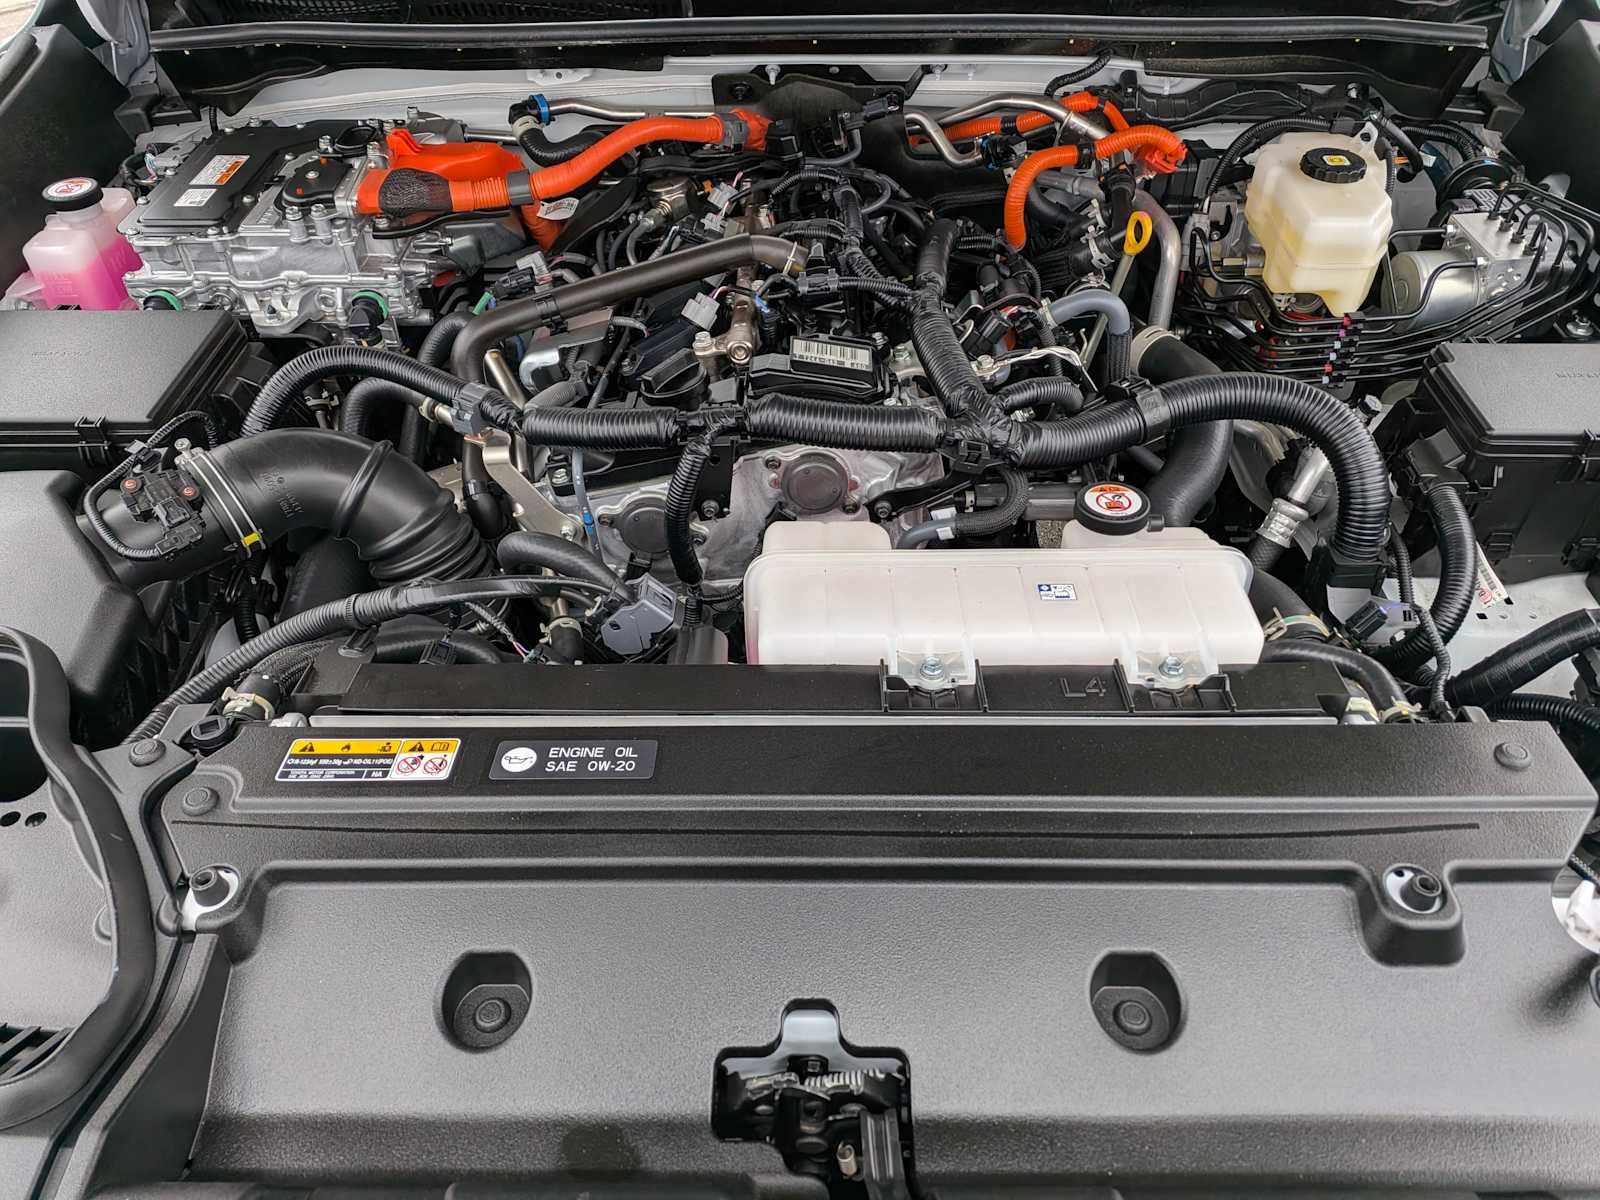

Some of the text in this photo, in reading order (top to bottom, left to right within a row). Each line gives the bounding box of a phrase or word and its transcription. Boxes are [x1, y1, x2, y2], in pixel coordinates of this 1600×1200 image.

[1060, 676, 1106, 697] L4
[548, 747, 638, 758] ENGINE OIL
[545, 760, 636, 772] SAE 0W-20
